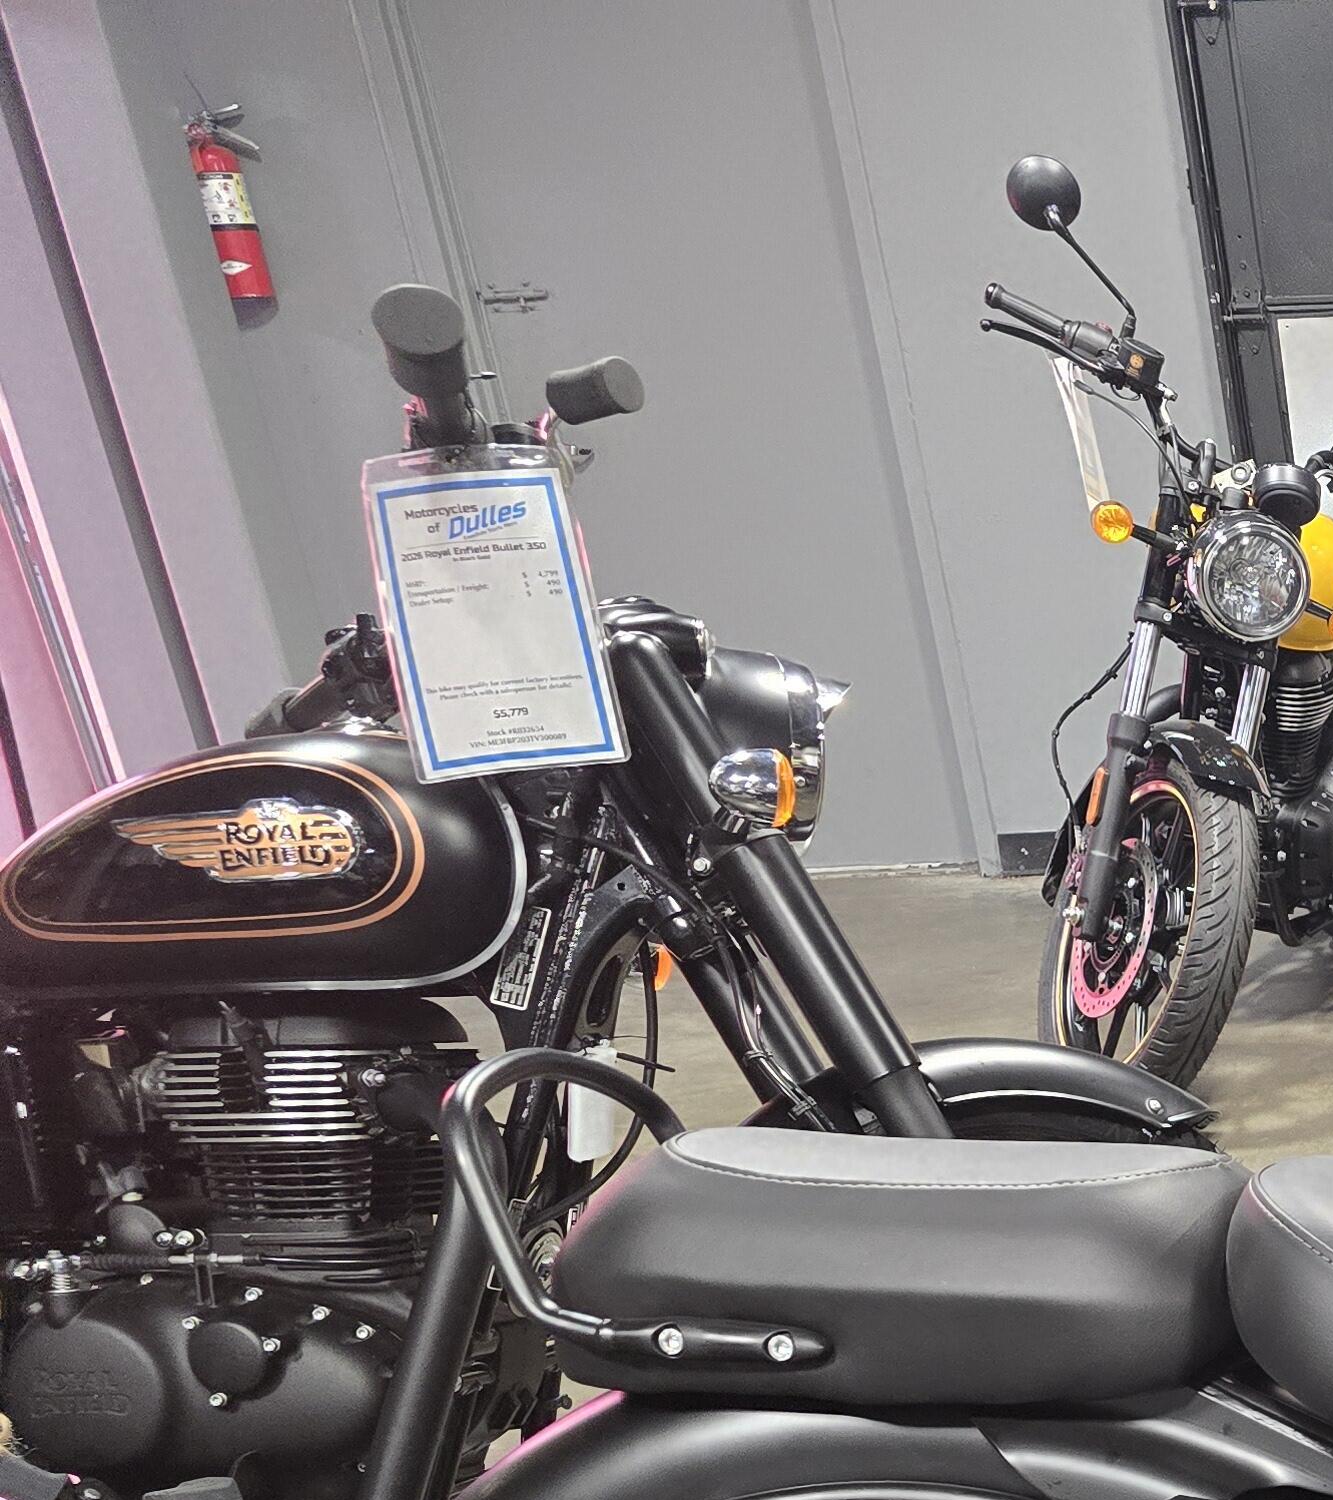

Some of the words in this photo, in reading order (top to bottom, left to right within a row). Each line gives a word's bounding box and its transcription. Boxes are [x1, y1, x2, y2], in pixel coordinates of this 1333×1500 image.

[404, 503, 479, 520] Motorcycles
[428, 522, 440, 534] of
[449, 501, 527, 540] Dulles
[424, 549, 451, 560] Royal
[454, 545, 490, 557] Enfield
[492, 543, 524, 552] Bullet
[526, 541, 547, 550] 350
[493, 706, 529, 720] $5,779
[486, 728, 507, 738] Stock
[224, 820, 318, 845] ROYAL
[218, 844, 332, 871] ENFIELD
